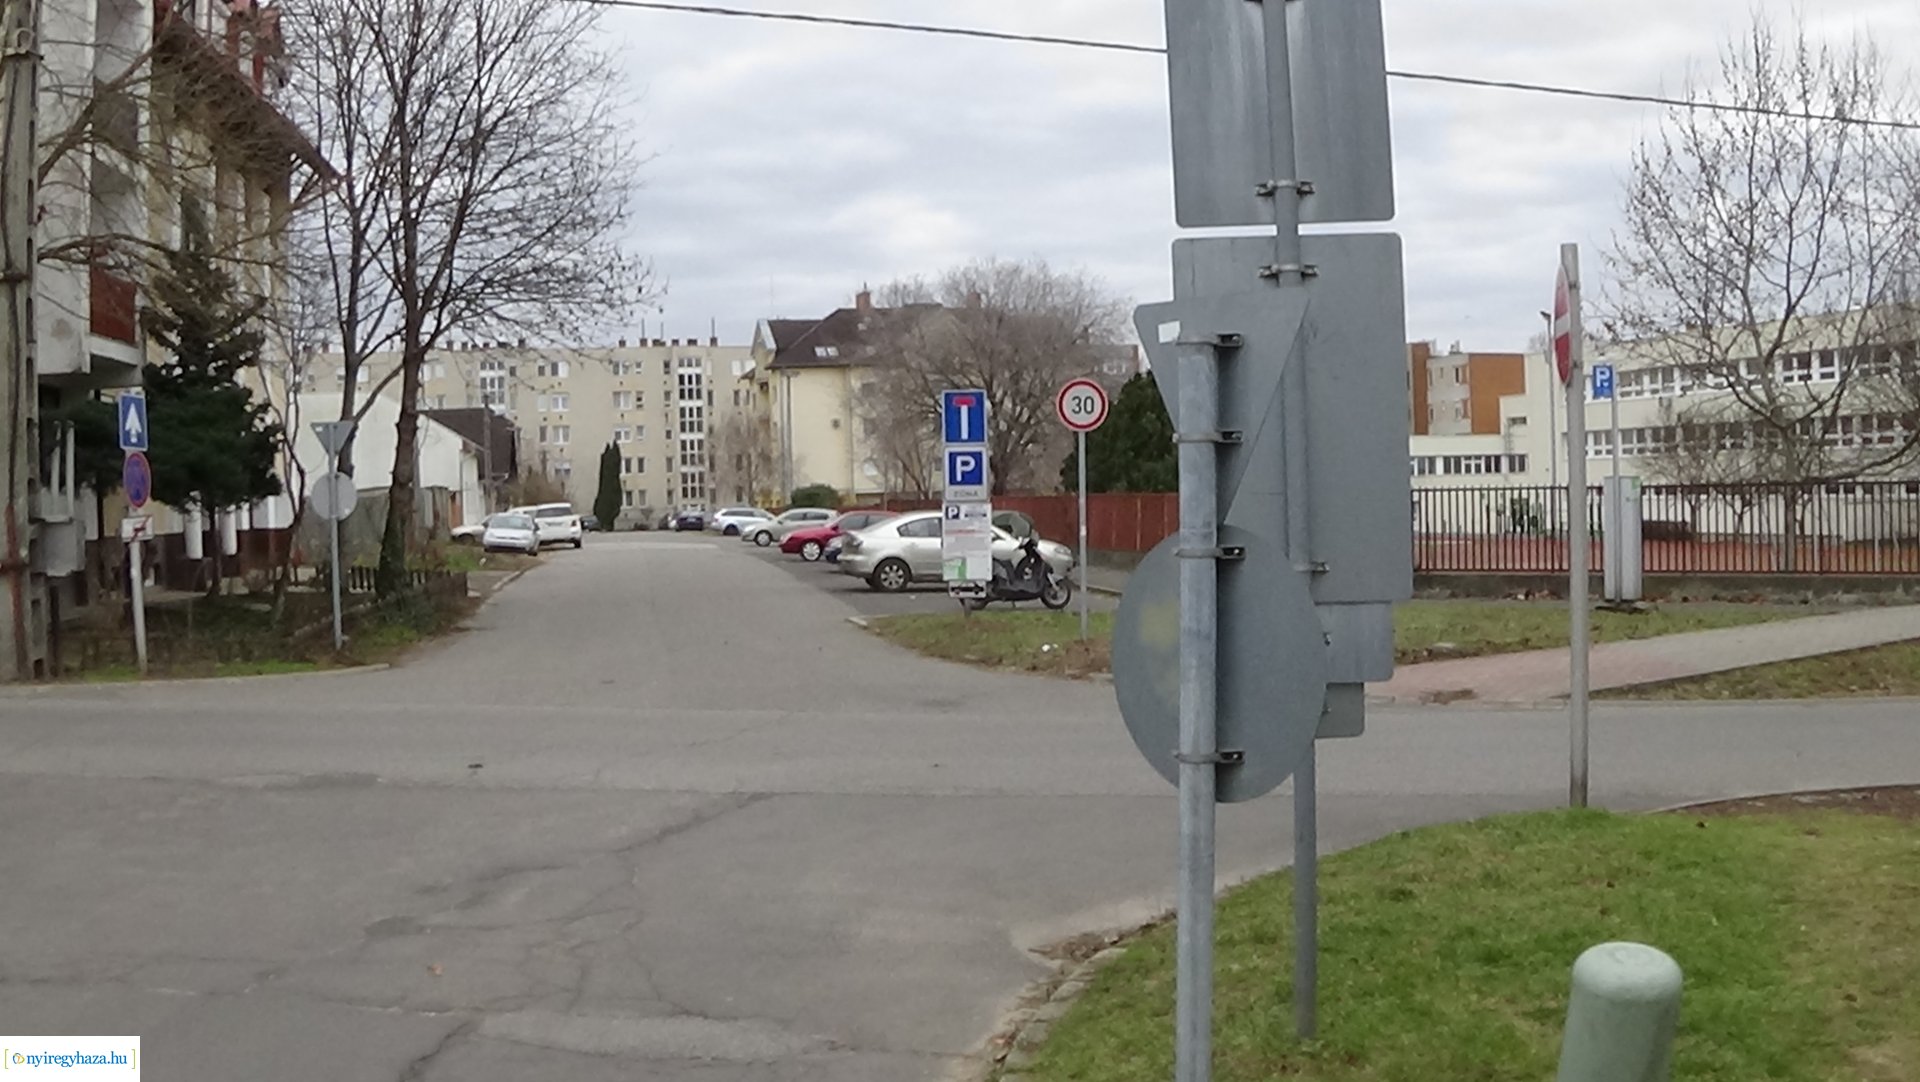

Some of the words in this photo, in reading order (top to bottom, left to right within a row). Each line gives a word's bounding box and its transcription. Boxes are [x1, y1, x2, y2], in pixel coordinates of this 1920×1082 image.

[1596, 367, 1610, 387] P
[1072, 395, 1094, 415] 30
[956, 455, 976, 482] P
[948, 507, 958, 519] P
